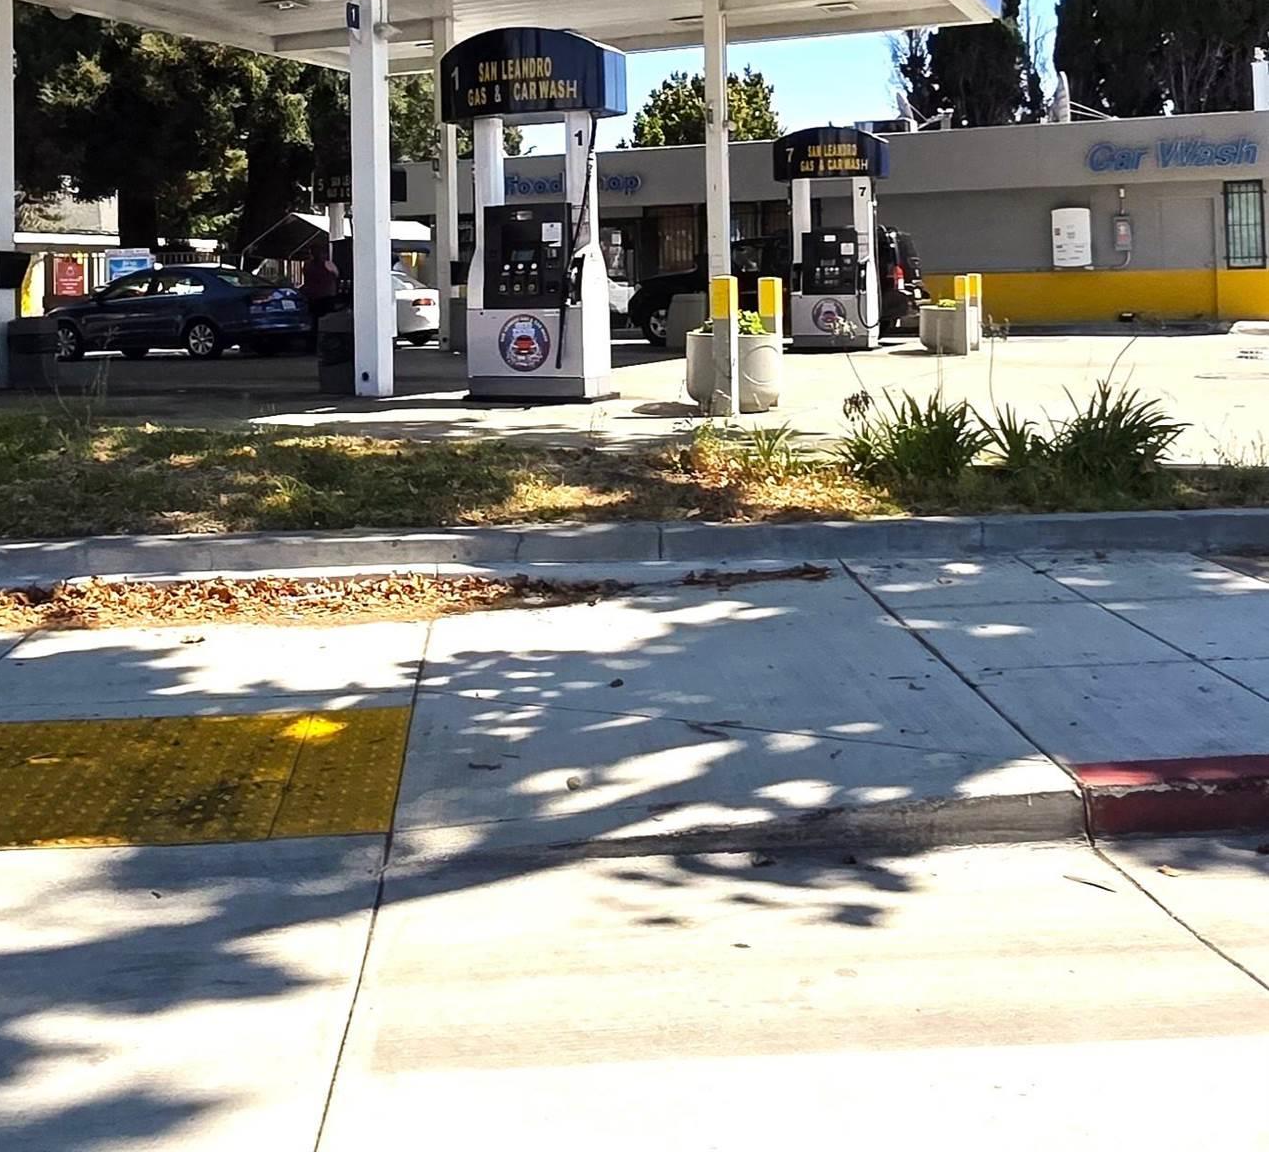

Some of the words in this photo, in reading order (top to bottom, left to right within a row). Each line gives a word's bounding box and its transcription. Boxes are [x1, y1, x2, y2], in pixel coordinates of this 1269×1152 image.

[451, 65, 459, 91] 1
[478, 61, 497, 83] SAN
[501, 56, 553, 81] LEANDRO
[467, 86, 487, 107] GAS
[494, 84, 501, 103] &
[513, 81, 537, 101] CAR
[538, 79, 578, 99] WASH
[574, 130, 583, 147] 1
[786, 147, 795, 163] 7
[808, 144, 822, 158] SAN
[824, 143, 858, 157] LEANDRO
[1087, 143, 1148, 172] Car
[1156, 136, 1259, 169] Wash
[800, 160, 815, 172] GAS
[827, 158, 843, 171] CAR
[844, 158, 869, 171] WASH
[505, 171, 565, 195] Food
[858, 187, 867, 197] 7
